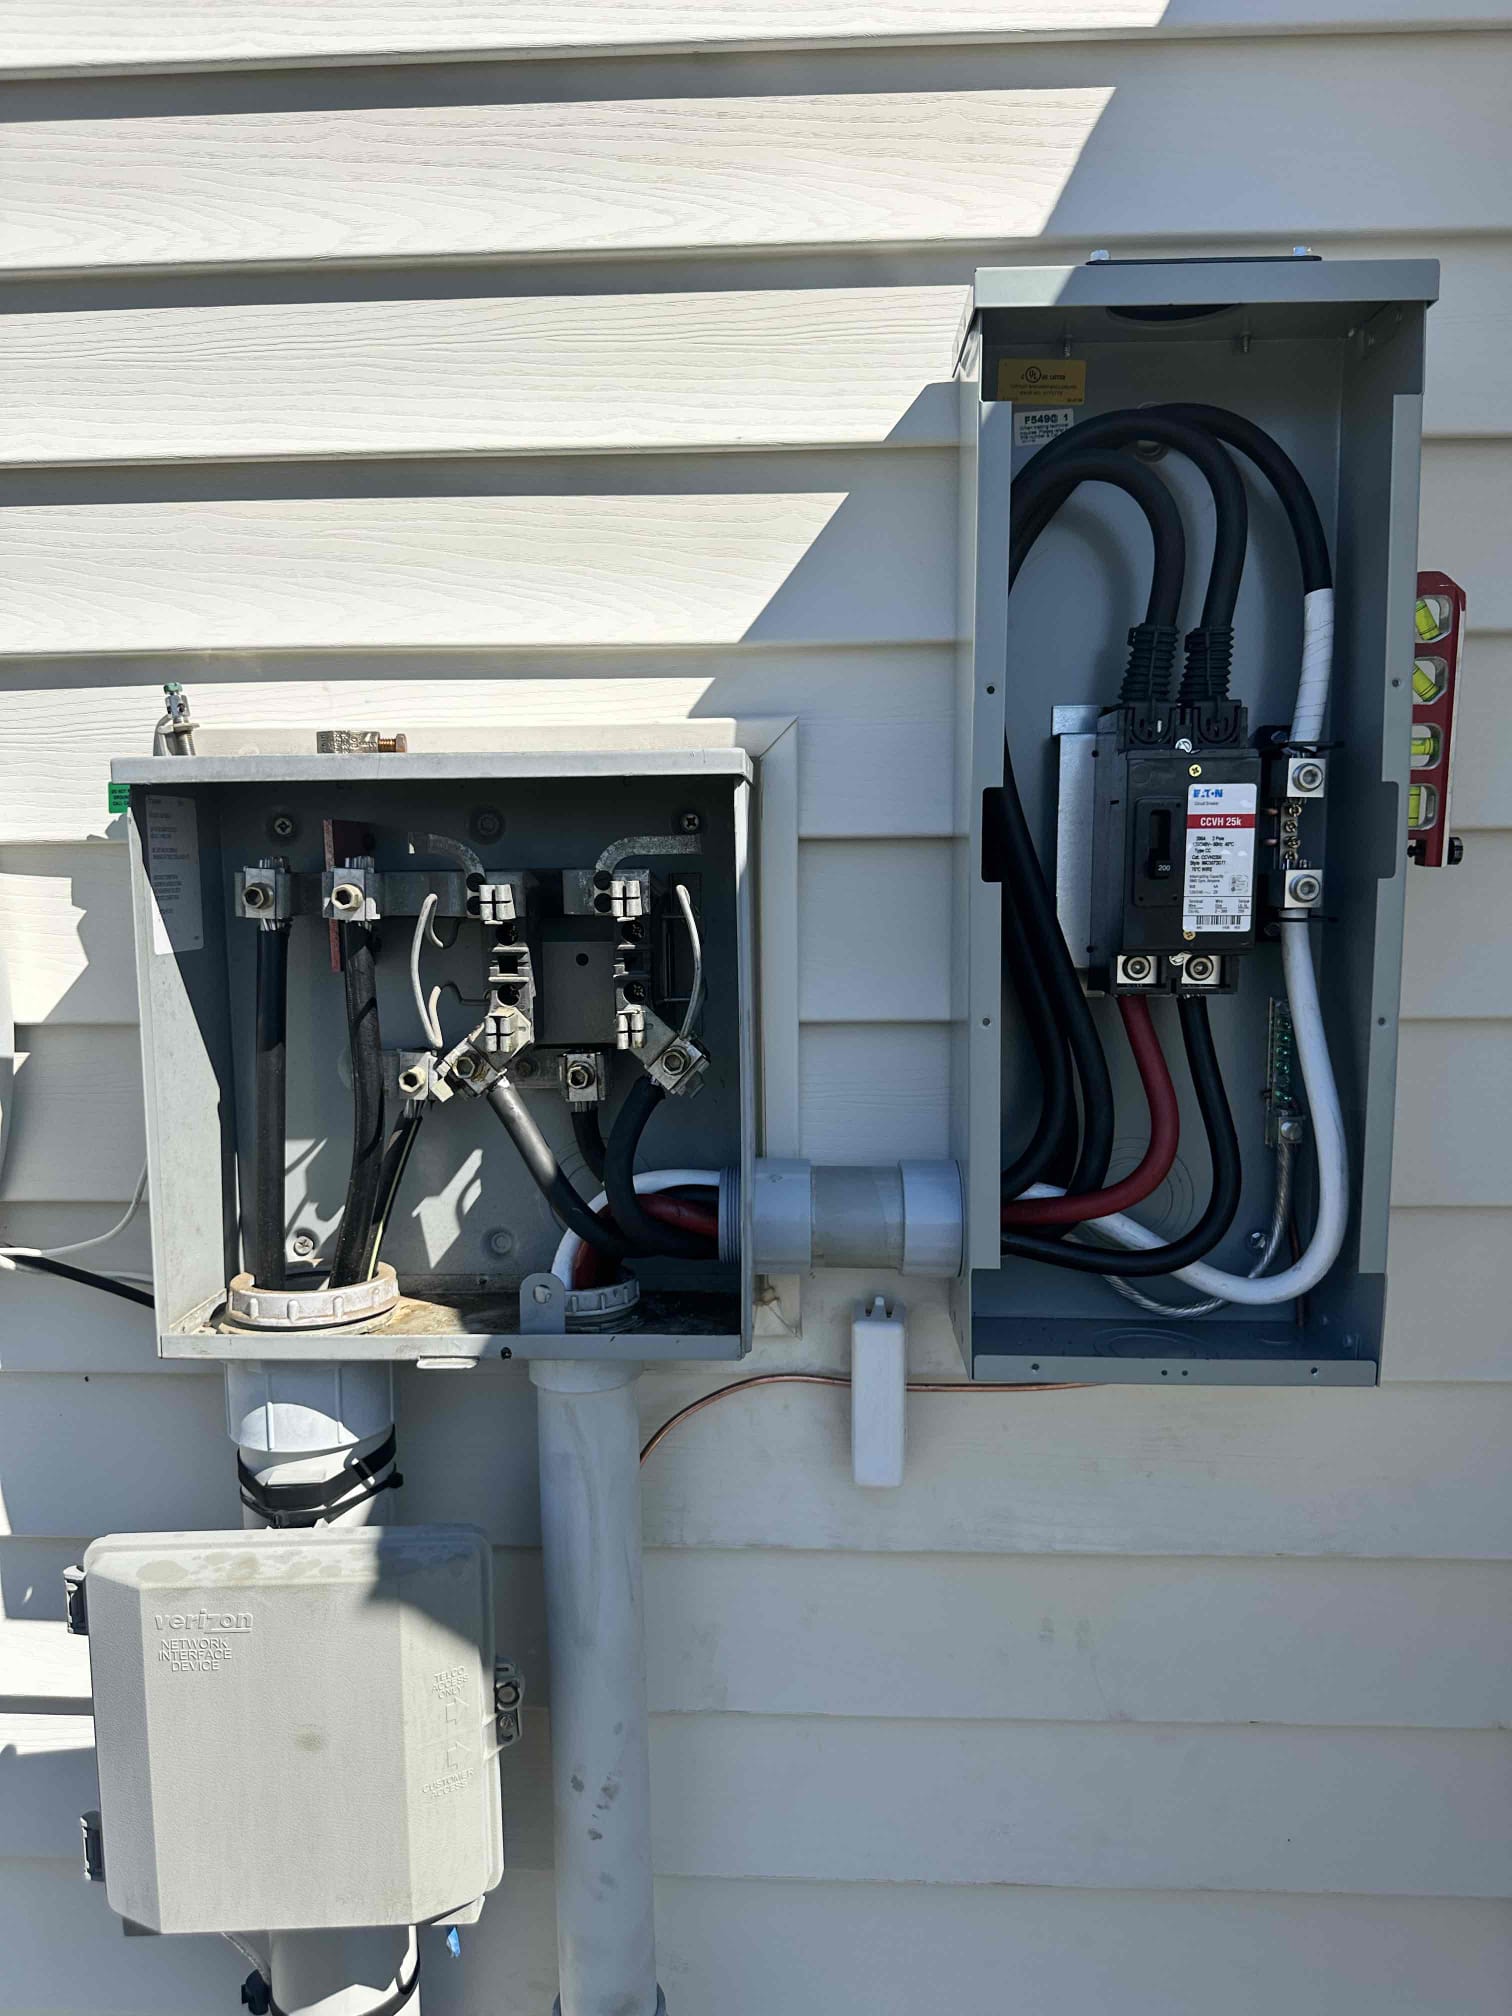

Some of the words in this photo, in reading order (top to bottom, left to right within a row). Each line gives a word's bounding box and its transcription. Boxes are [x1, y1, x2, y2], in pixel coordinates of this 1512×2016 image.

[1200, 817, 1224, 827] CCVH
[1226, 817, 1242, 827] 25k
[1157, 864, 1171, 872] 200
[154, 1608, 254, 1634] verizon
[160, 1638, 229, 1651] NETWORK
[158, 1649, 233, 1662] INTERFACE
[171, 1660, 221, 1673] DEVICE
[433, 1665, 466, 1683] TELCO
[431, 1674, 470, 1693] ACCESS
[437, 1685, 464, 1700] ONLY
[421, 1767, 476, 1794] CUSTOMER
[430, 1779, 470, 1800] ACCESS
